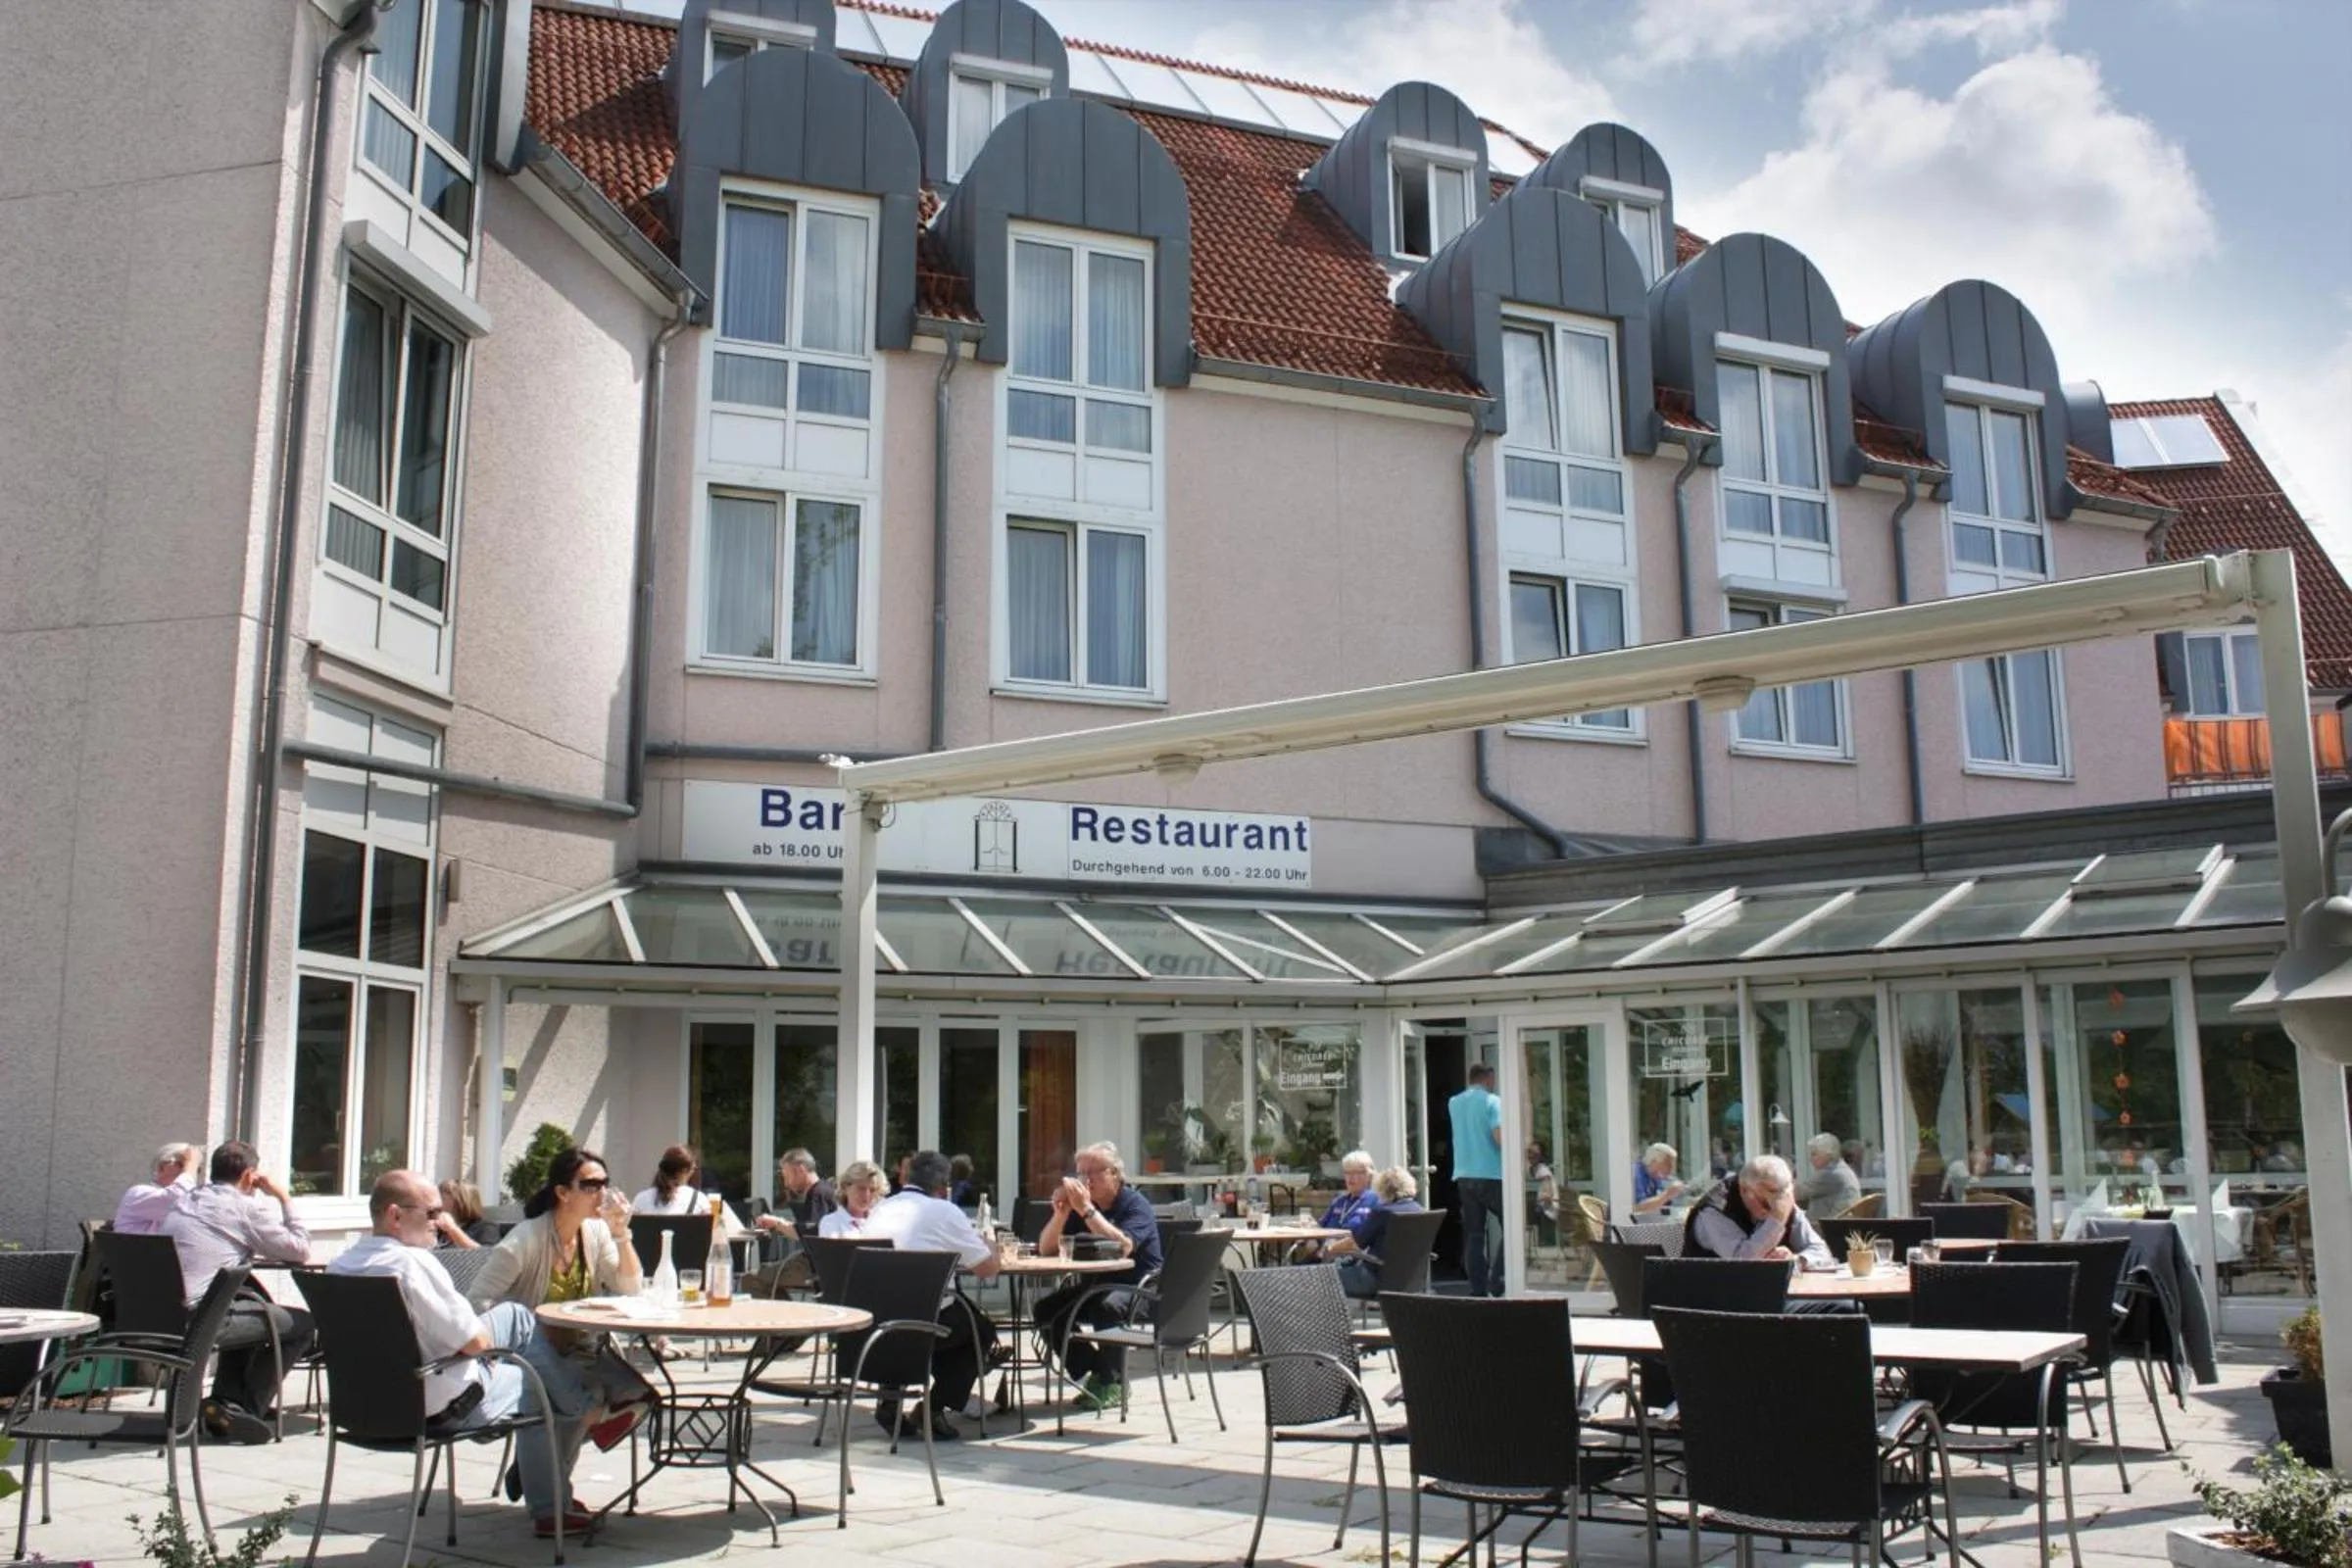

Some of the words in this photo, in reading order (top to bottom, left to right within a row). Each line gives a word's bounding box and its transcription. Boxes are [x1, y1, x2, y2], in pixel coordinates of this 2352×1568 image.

[760, 788, 845, 830] Bar
[1071, 807, 1307, 852] Restaurant
[752, 843, 772, 856] ab
[780, 844, 820, 857] 18.00
[1072, 858, 1165, 875] Durchgehend
[1170, 865, 1194, 875] von
[1201, 865, 1230, 877] 6.00
[1245, 867, 1281, 878] 22.00
[1285, 867, 1307, 880] Uhr
[1281, 1071, 1321, 1086] Eingang
